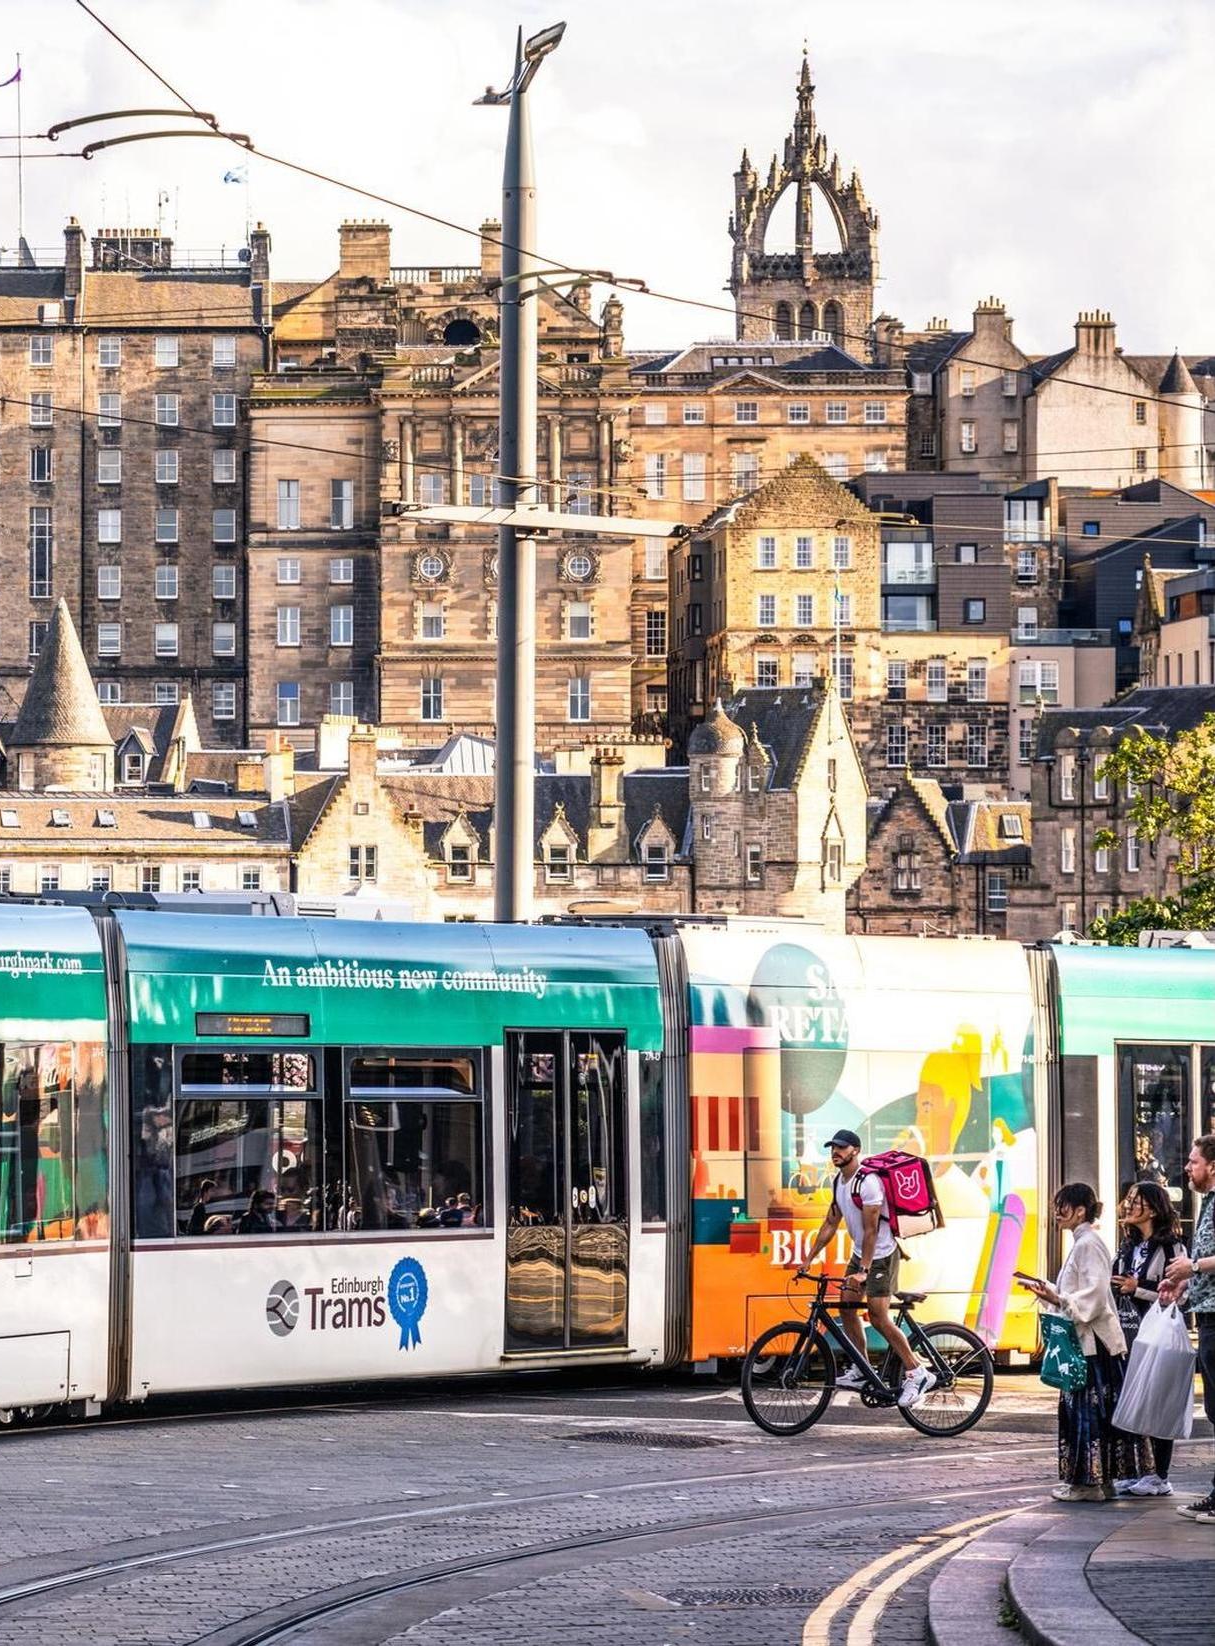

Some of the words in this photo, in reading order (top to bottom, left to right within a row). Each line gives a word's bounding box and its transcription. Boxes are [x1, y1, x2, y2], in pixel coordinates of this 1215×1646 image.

[262, 960, 292, 987] An
[296, 960, 394, 989] ambitious
[398, 968, 437, 990] new
[442, 965, 547, 999] community
[331, 1276, 384, 1296] Edinburgh
[304, 1287, 386, 1330] Trams
